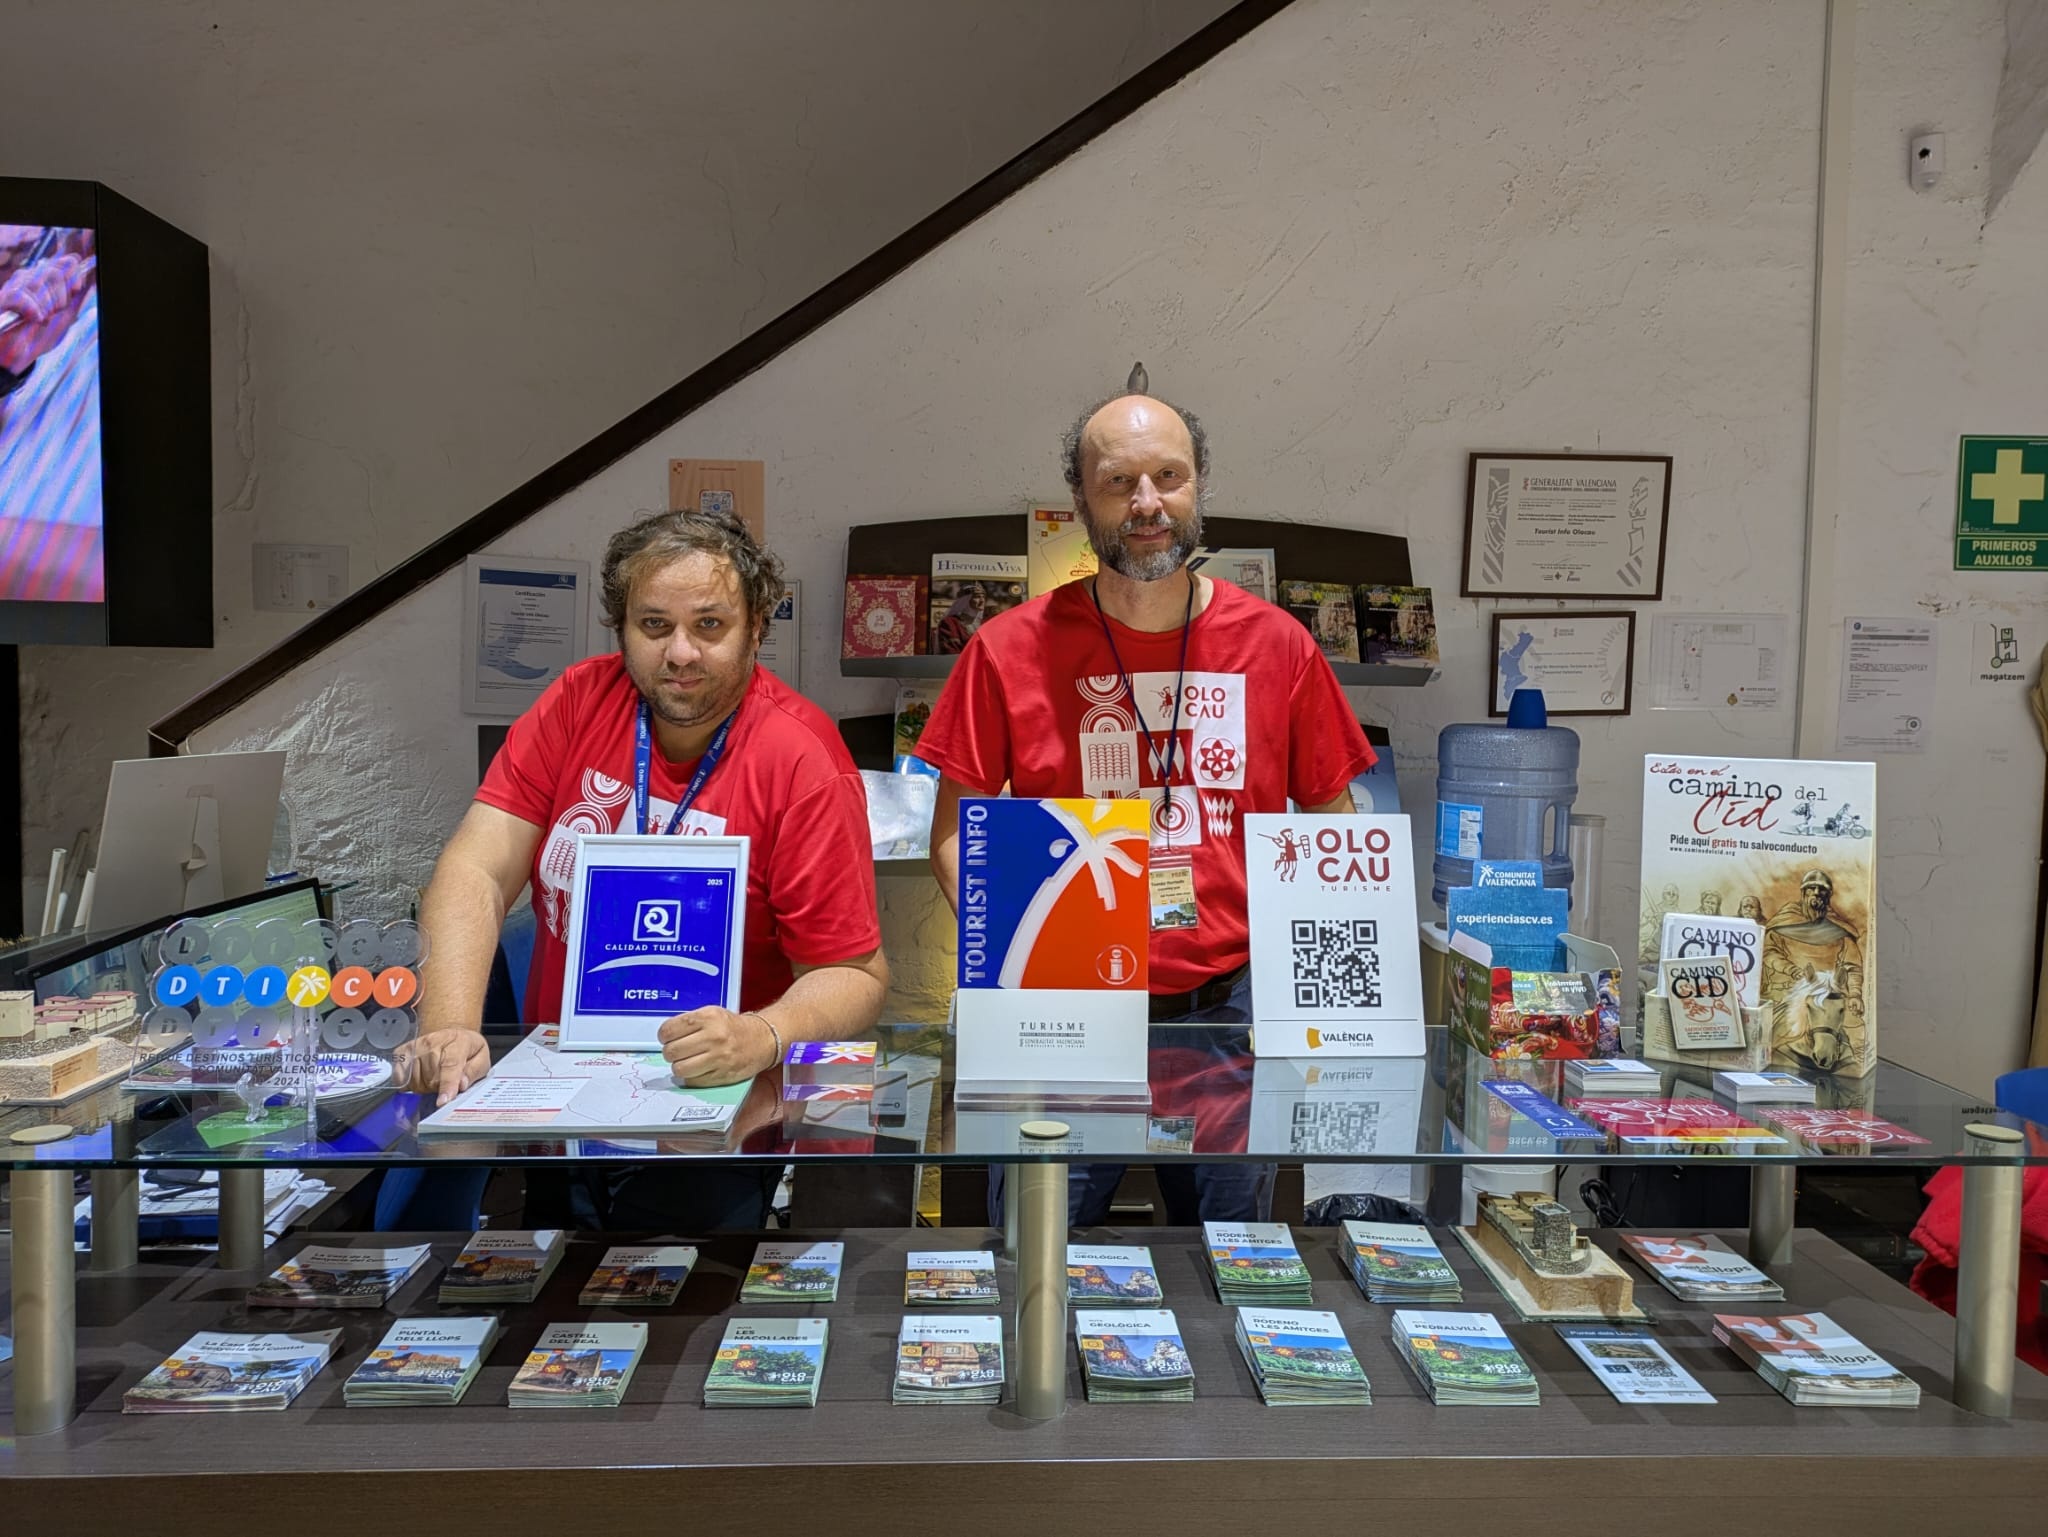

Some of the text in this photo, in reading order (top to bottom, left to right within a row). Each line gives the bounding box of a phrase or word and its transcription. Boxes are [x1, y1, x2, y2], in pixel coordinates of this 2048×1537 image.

[1530, 478, 1617, 488] GENERALITAT VALENCIANA
[1972, 540, 2037, 552] PRIMEROS
[1974, 554, 2033, 566] AUXILIOS
[1980, 673, 2025, 682] magatzem
[1184, 685, 1226, 702] OLO
[1184, 702, 1225, 719] CAU
[1687, 768, 1708, 776] en
[1668, 774, 1828, 801] camino del
[1693, 786, 1780, 835] Cid
[1315, 828, 1391, 854] OLO
[1670, 834, 1818, 854] Pide aquí gratis tu salvoconducto
[1317, 856, 1391, 883] CAU
[1494, 871, 1536, 879] COMUNITAT
[707, 878, 723, 886] 2025
[1485, 878, 1537, 887] VALENCIANA
[964, 804, 989, 984] TOURIST INFO
[1456, 913, 1553, 926] experienciascv.es
[1681, 927, 1756, 947] CAMINO
[604, 943, 706, 953] CALIDAD TURÍSTICA
[1670, 965, 1726, 978] CAMINO
[1671, 975, 1728, 999] CID
[624, 989, 659, 1000] ICTES
[1020, 1022, 1086, 1031] TURISME
[1322, 1029, 1374, 1042] VALÈNCIA
[186, 1053, 244, 1063] DESTINOS
[249, 1052, 318, 1063] TURÍSTICOS
[318, 1053, 406, 1063] INTELIGENTES
[198, 1065, 344, 1075] COMUNITAT VALENCIANA
[274, 1076, 300, 1086] 2024
[1359, 1234, 1425, 1243] PEDRALVILLA
[1282, 1325, 1330, 1333] AMITGES
[1413, 1323, 1488, 1332] PEDRALVILLA
[1822, 1353, 1878, 1365] llops
